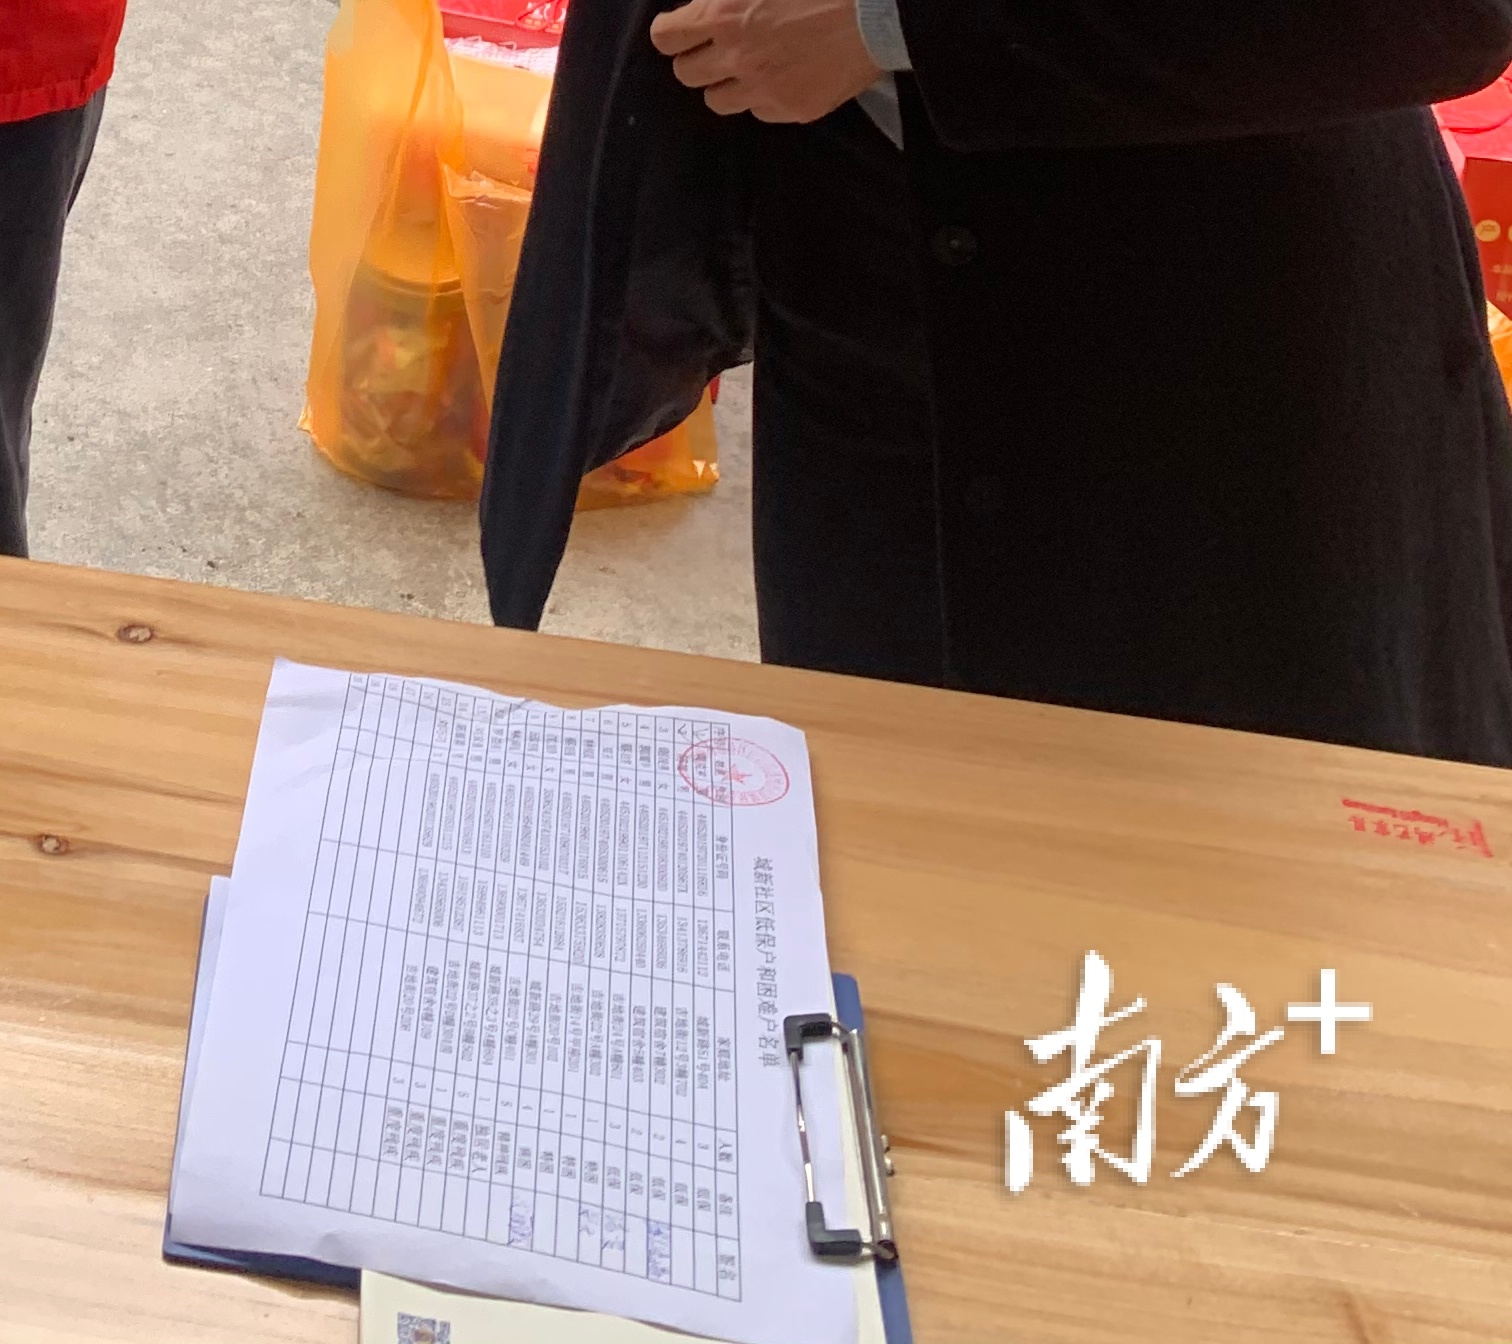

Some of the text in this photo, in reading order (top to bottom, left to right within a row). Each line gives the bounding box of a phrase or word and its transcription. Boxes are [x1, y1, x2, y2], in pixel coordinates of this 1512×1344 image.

[753, 855, 779, 1068] 城新社区低保户和困难户名单
[717, 1137, 732, 1164] 人数
